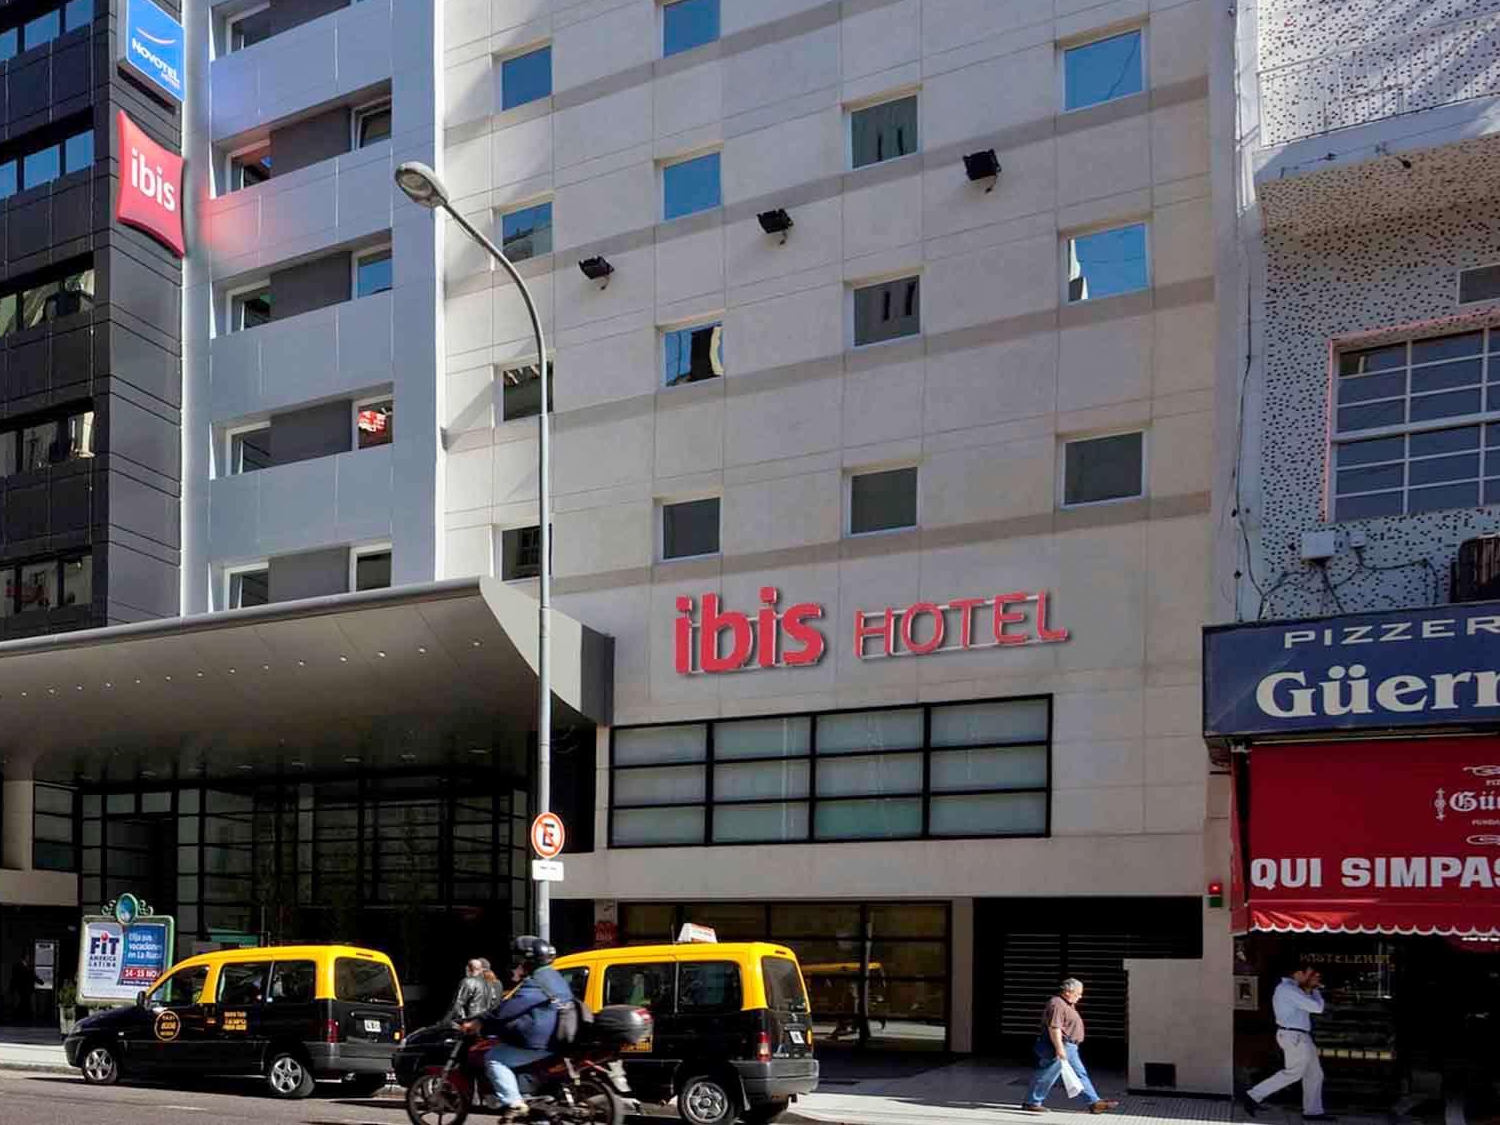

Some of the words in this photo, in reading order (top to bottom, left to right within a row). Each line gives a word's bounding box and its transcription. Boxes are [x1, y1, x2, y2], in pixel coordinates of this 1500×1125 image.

[131, 37, 181, 84] NOVOTEL
[131, 147, 175, 213] ibis
[675, 586, 825, 675] ibis
[853, 589, 1070, 659] HOTEL
[1449, 790, 1500, 812] Gü
[1251, 857, 1323, 890] QUI
[1341, 856, 1500, 889] SIMPA
